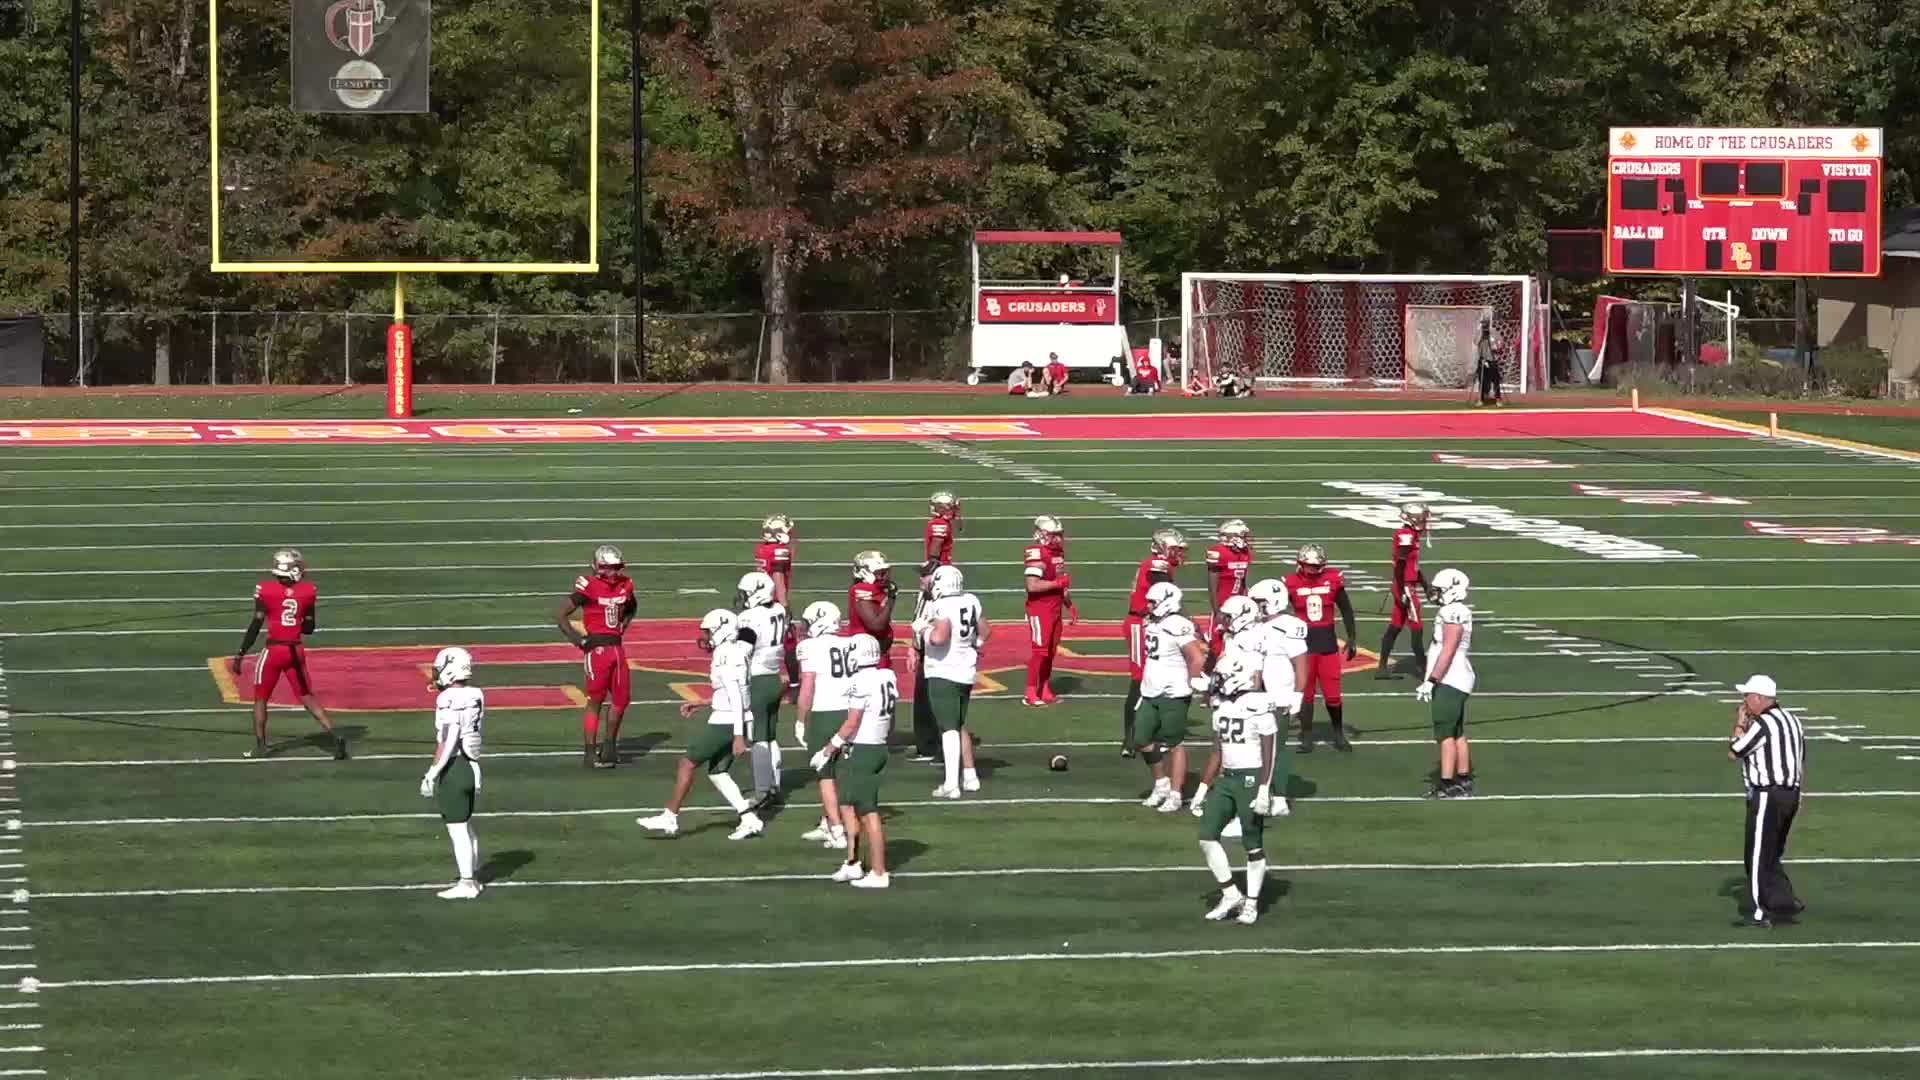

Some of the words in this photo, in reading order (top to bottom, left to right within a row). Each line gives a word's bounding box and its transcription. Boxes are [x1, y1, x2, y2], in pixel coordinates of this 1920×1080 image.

[1655, 135, 1694, 149] HOME
[1697, 135, 1714, 149] OF
[1718, 136, 1746, 149] THE
[1750, 136, 1833, 149] CRUSADERS
[1611, 162, 1681, 175] CRUSADERS
[1821, 163, 1872, 177] VISITOR
[1613, 226, 1646, 239] BALL
[1647, 227, 1664, 240] ON
[1702, 227, 1728, 241] QTR
[1752, 228, 1788, 241] DOWN
[1828, 229, 1846, 242] TO
[1847, 229, 1863, 242] GO
[1008, 302, 1086, 313] CRUSADERS
[394, 330, 405, 415] CRUSADERS
[281, 598, 298, 626] 2
[959, 605, 978, 638] 54
[769, 612, 786, 647] 77
[879, 680, 897, 717] 16
[1219, 716, 1246, 743] 22
